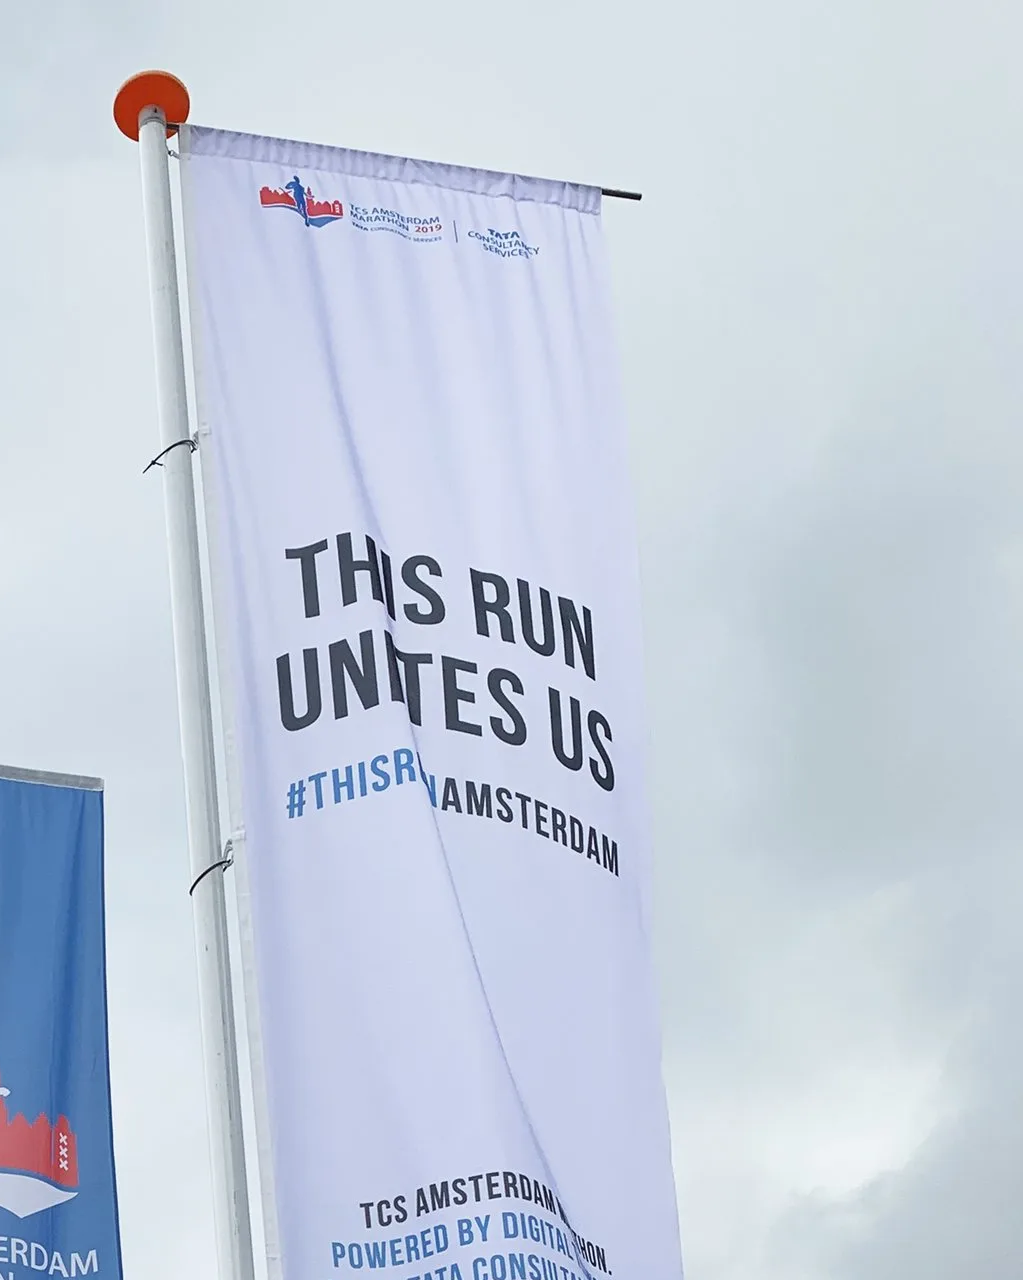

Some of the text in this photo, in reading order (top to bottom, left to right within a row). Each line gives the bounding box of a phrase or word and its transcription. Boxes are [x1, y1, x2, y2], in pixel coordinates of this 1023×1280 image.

[349, 203, 440, 226] TCS AMSTERDAM
[350, 210, 442, 233] MARATHON 2019
[487, 228, 520, 240] TATA
[284, 531, 597, 682] THIS RUN
[276, 629, 616, 792] UNITES US
[360, 1195, 408, 1229] TCS
[416, 1171, 556, 1217] AMSTERDAM
[332, 1223, 449, 1270] POWERED
[458, 1215, 491, 1246] BY
[502, 1211, 574, 1261] DIGITAL
